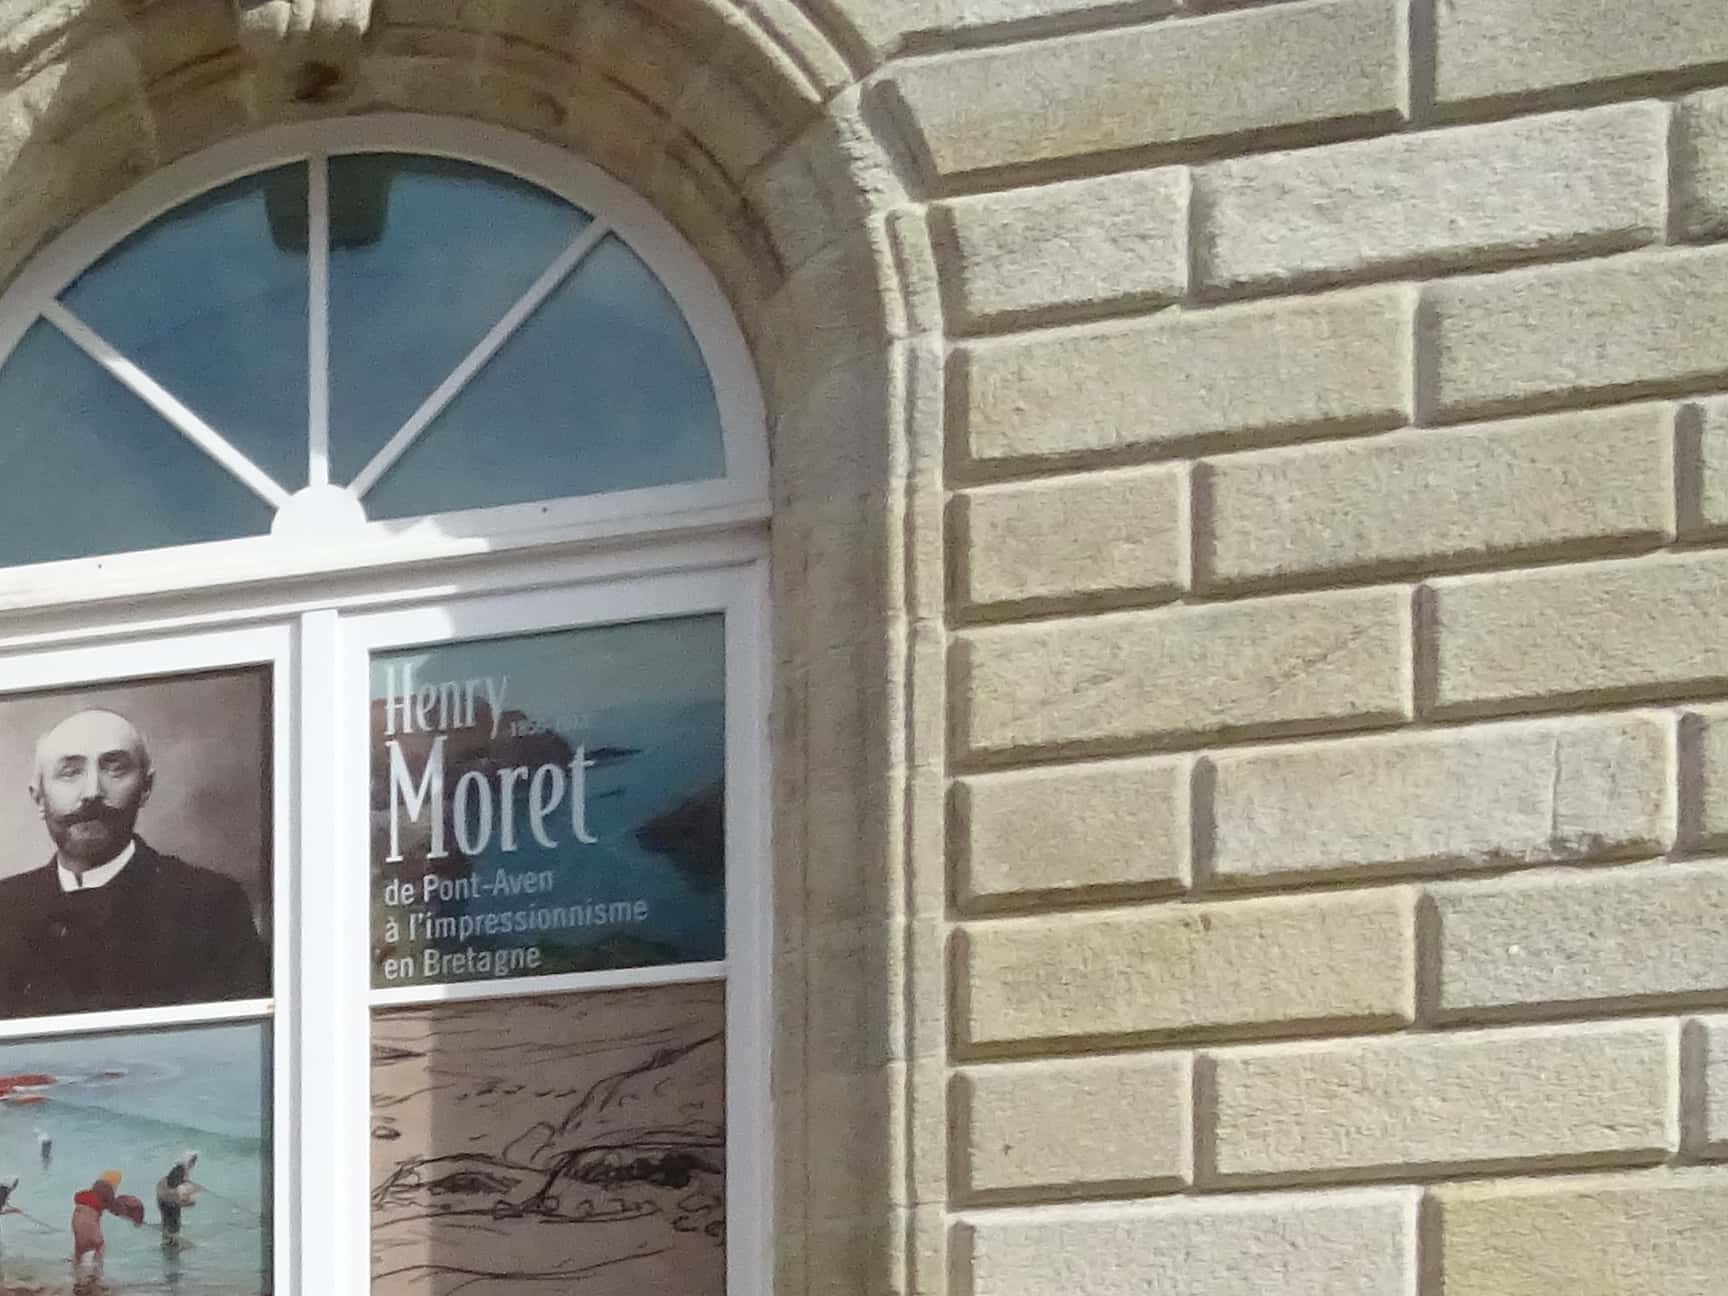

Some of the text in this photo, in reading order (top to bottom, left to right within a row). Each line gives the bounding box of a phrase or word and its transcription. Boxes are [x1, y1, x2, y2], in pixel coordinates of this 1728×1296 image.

[384, 662, 512, 740] Henry
[385, 735, 599, 863] Moret
[384, 868, 554, 907] de Pont-Aven
[384, 898, 648, 944] à l'impressionnisme
[384, 946, 543, 980] en Bretagne
